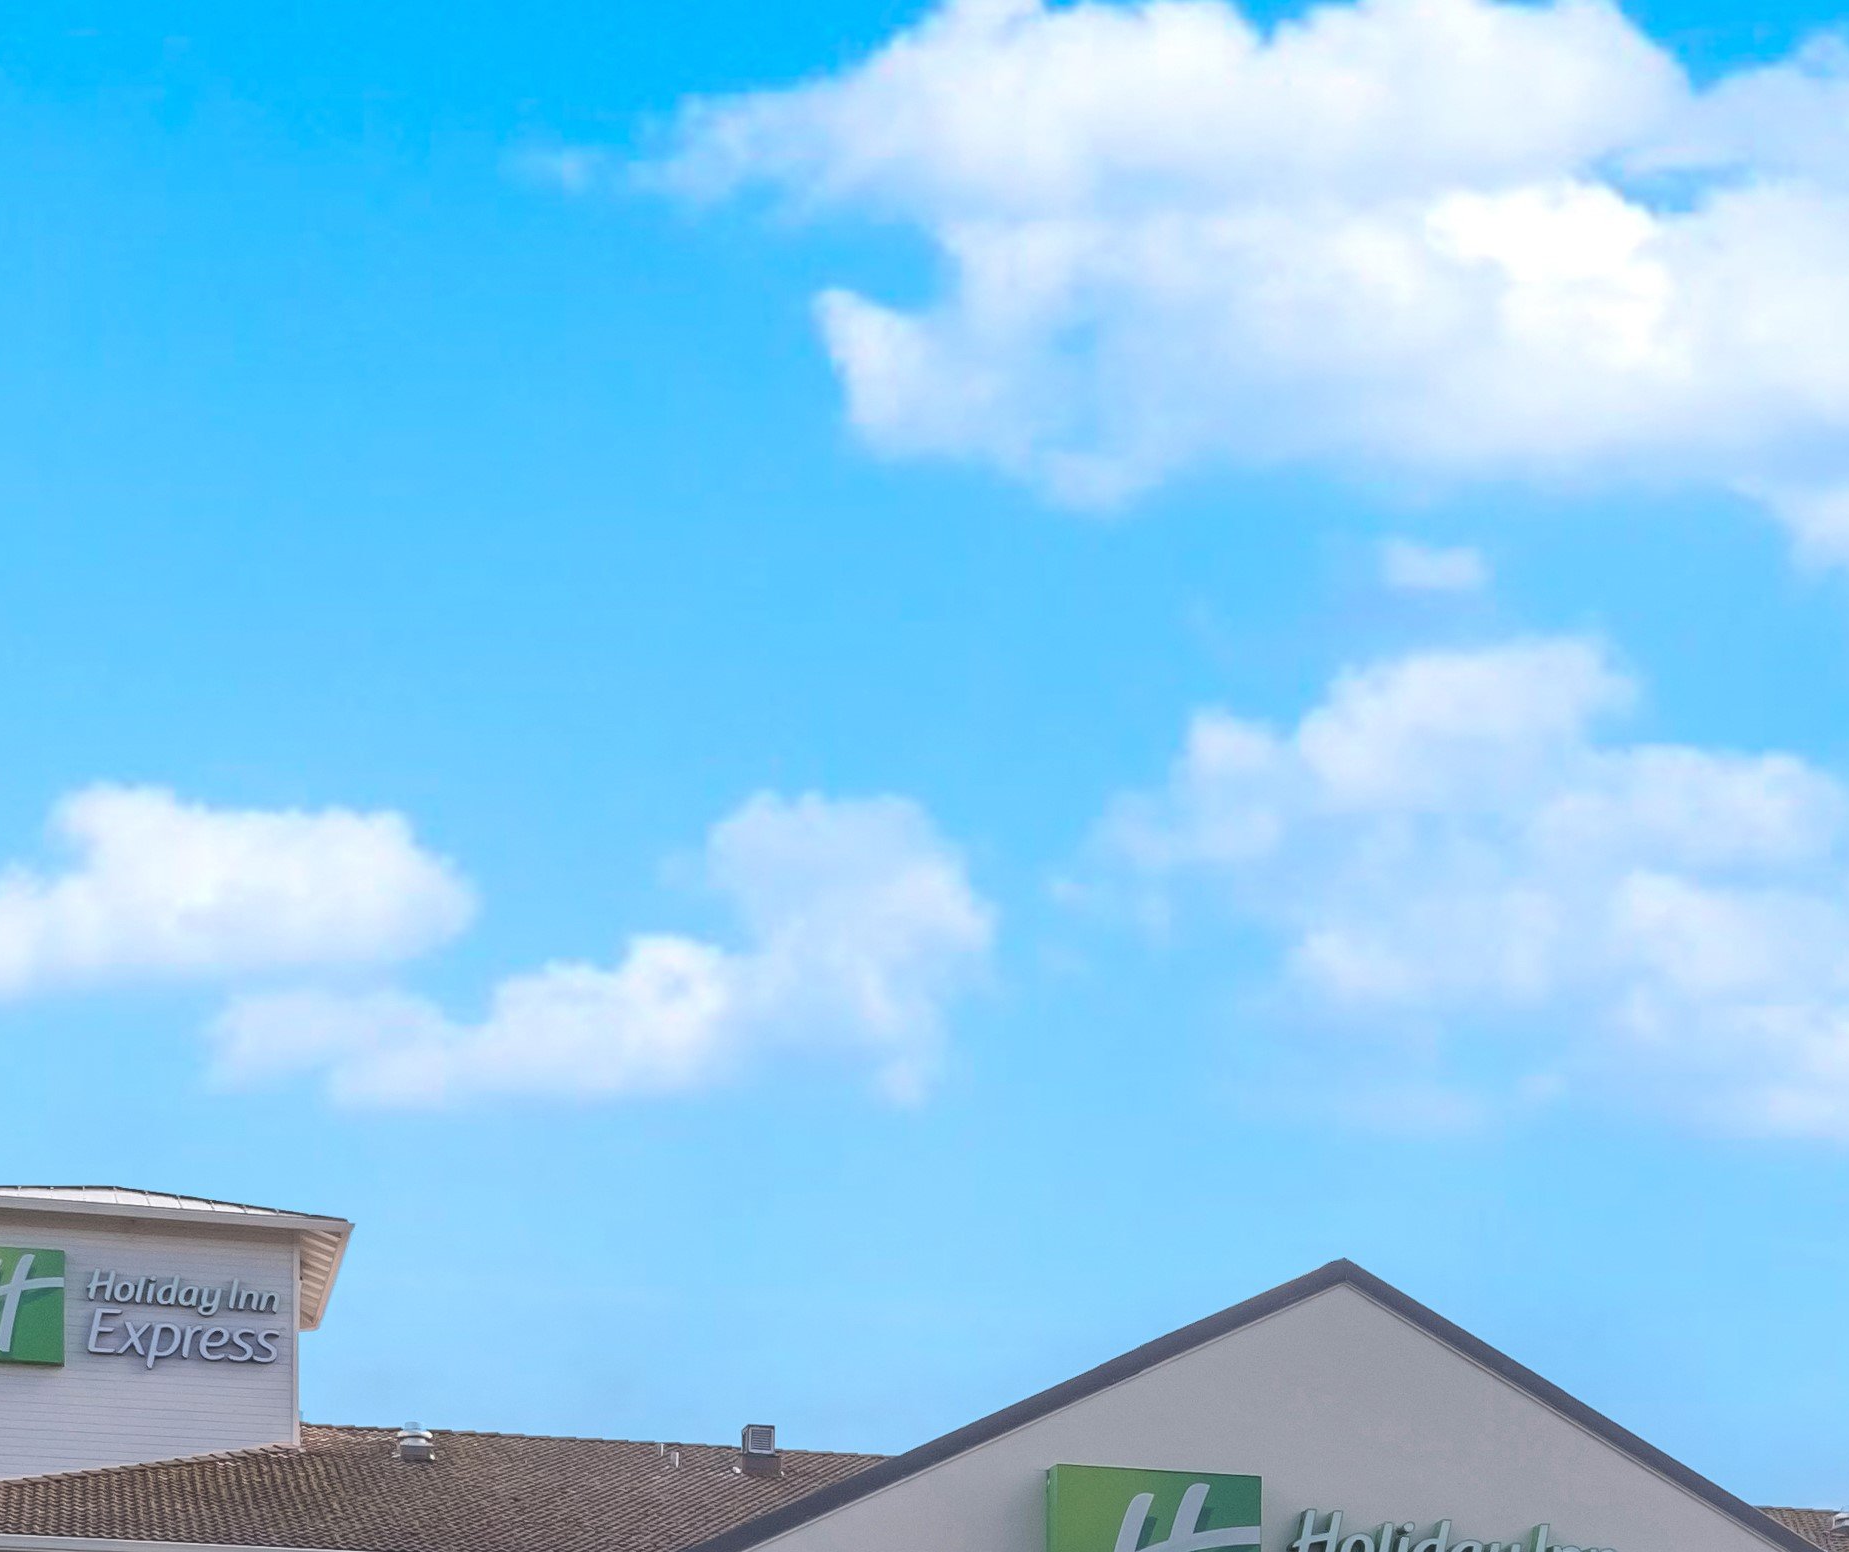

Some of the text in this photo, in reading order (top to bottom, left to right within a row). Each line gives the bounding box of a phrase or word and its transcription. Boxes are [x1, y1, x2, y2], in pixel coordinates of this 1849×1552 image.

[87, 1268, 280, 1317] Holiday Inn
[86, 1307, 280, 1369] Express
